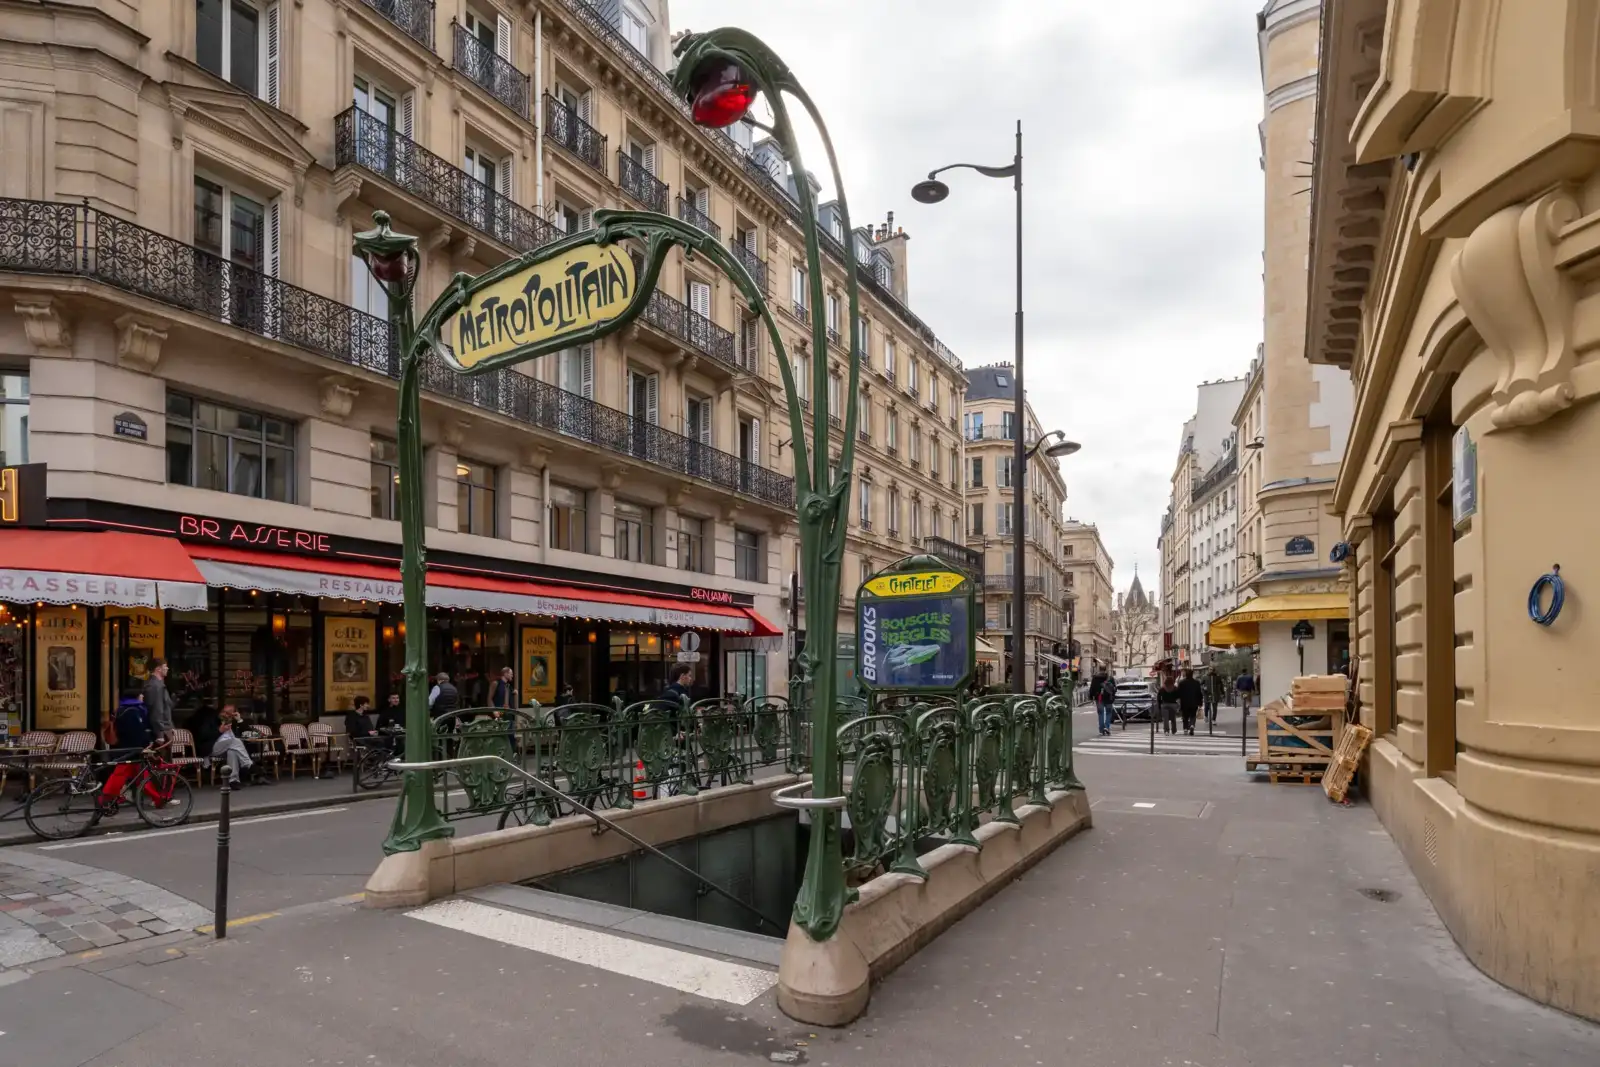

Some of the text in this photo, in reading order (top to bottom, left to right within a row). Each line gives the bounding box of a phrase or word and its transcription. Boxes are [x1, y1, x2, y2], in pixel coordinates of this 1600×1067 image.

[459, 251, 628, 355] METROPOLITAIN
[537, 599, 578, 613] BENJAMIN
[691, 587, 733, 604] BENJAMIN
[863, 605, 877, 681] BROOKS
